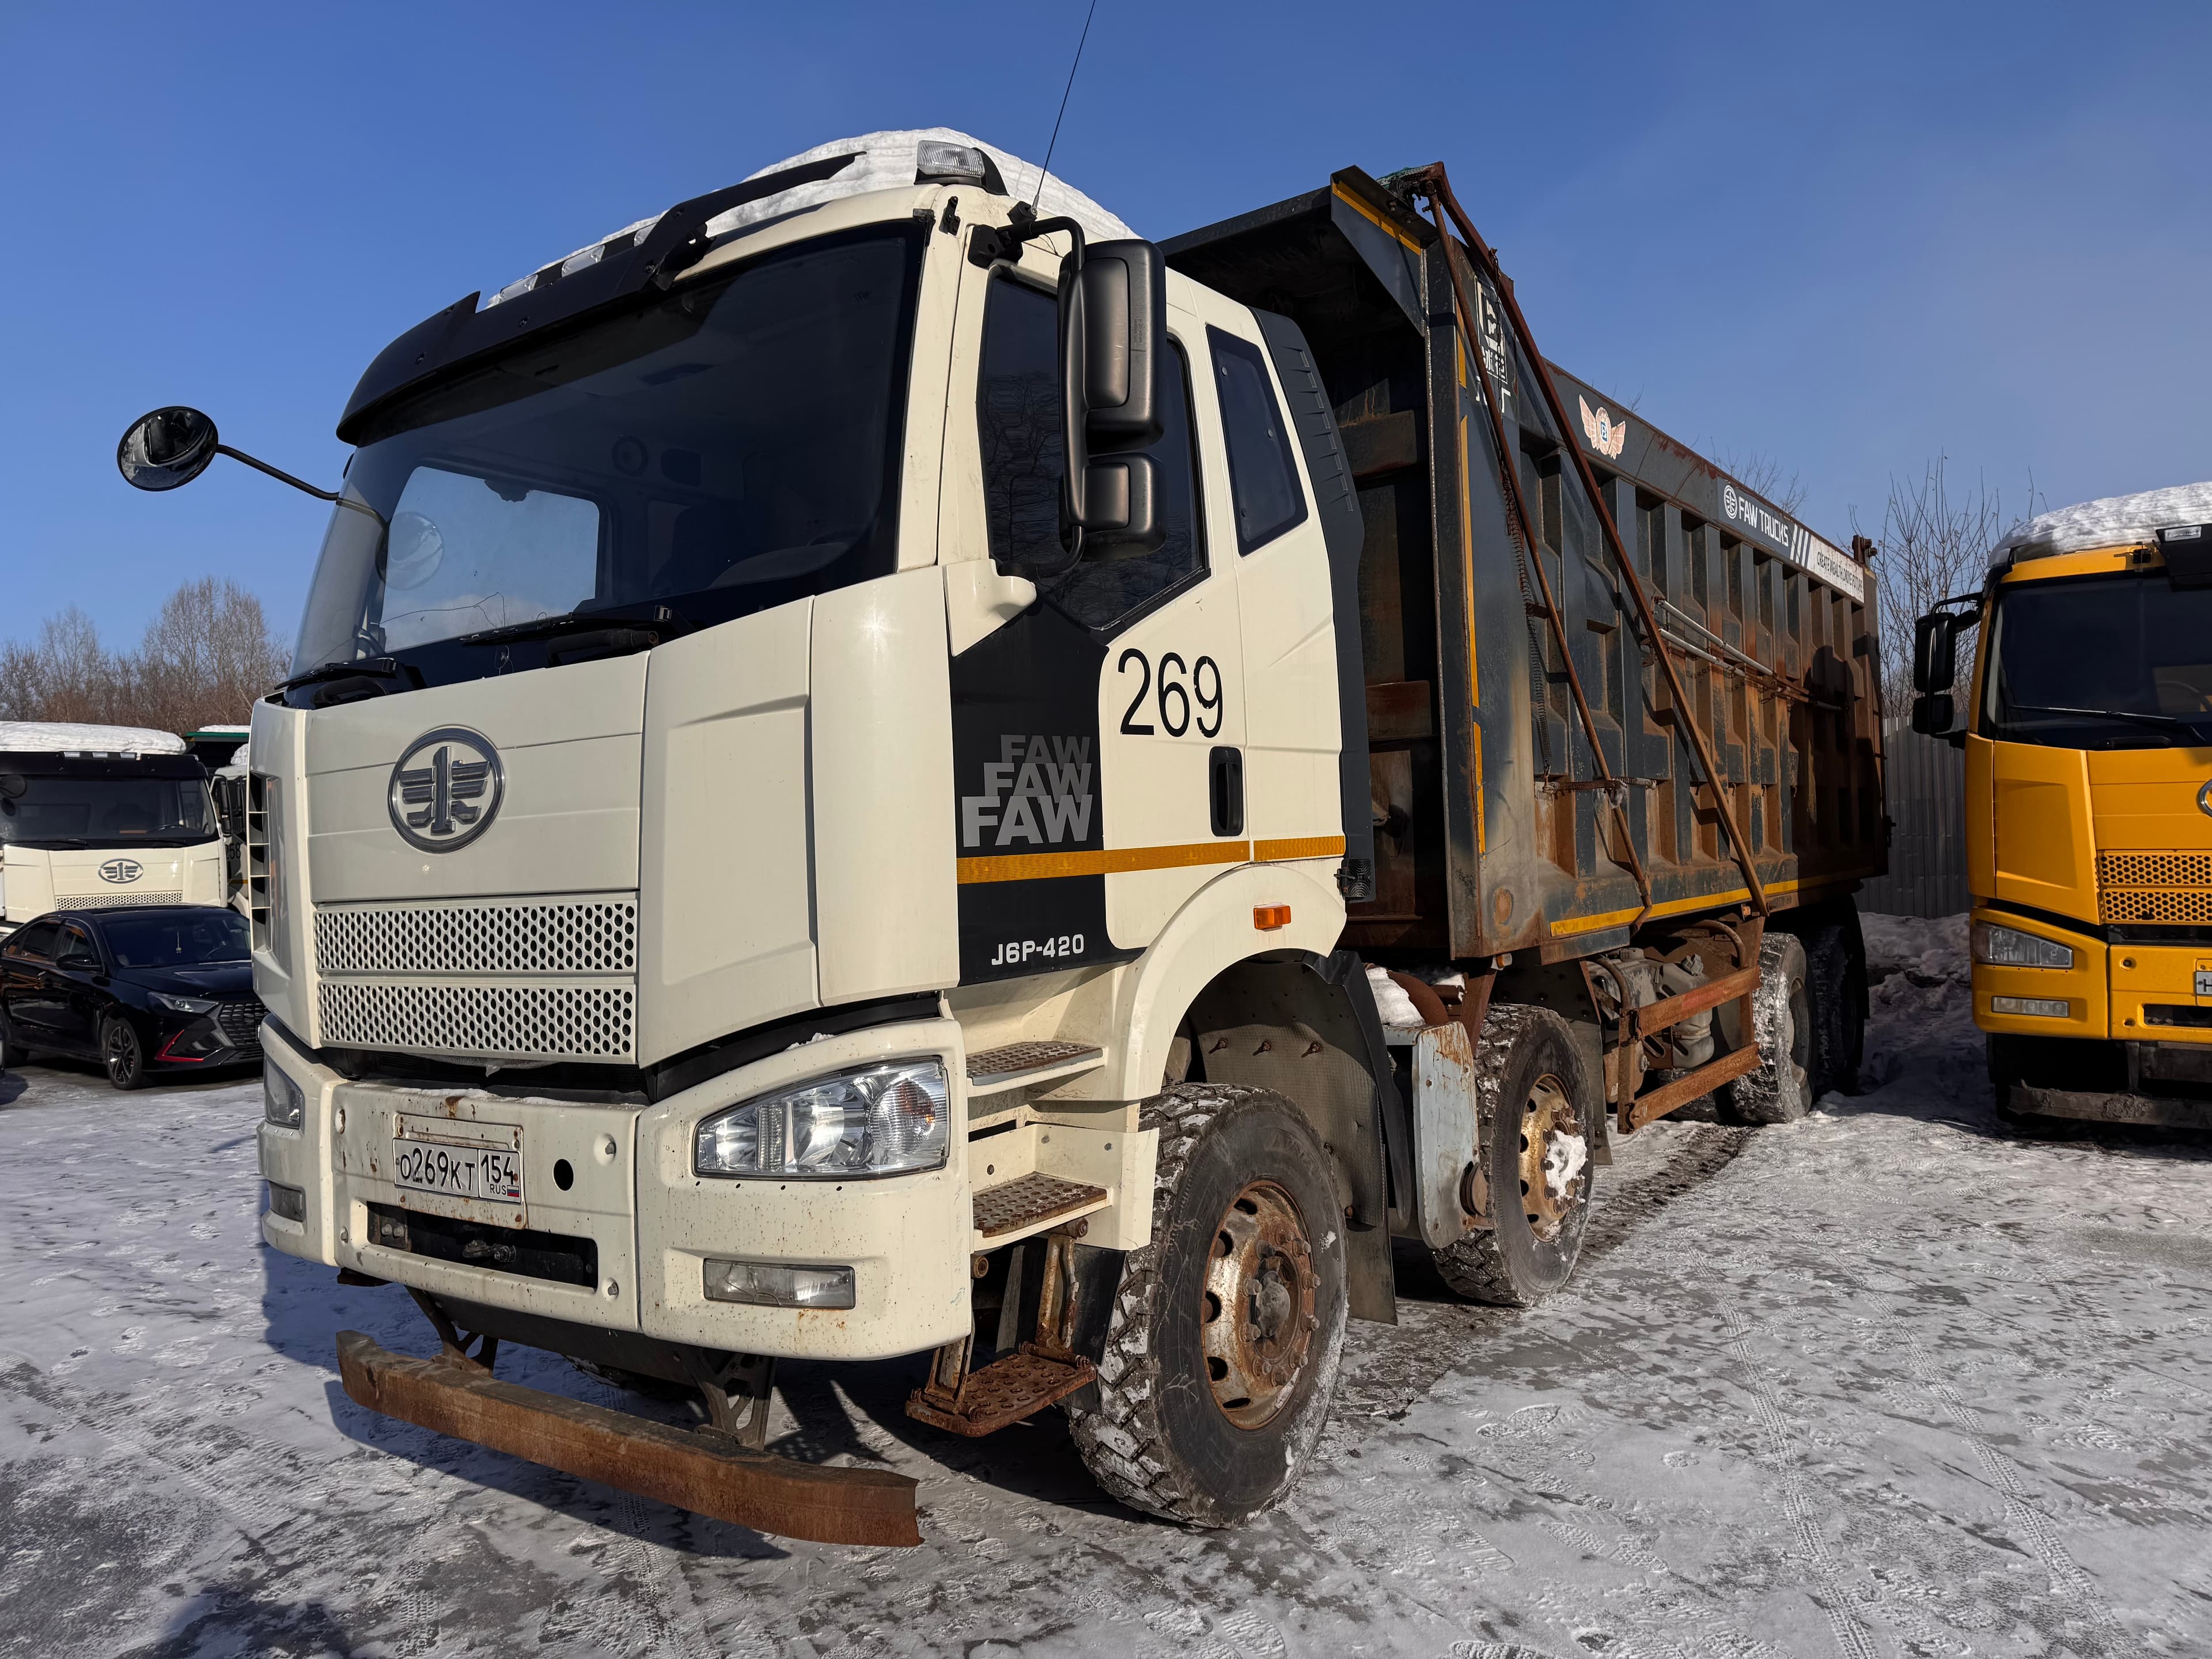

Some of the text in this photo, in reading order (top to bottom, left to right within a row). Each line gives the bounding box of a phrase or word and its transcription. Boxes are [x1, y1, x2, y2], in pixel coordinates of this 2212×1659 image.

[1738, 496, 1789, 547] FAW TRUCKS
[1118, 648, 1223, 738] 269
[1001, 734, 1090, 770] FAW
[984, 762, 1092, 804] FAW
[962, 794, 1093, 847] FAW
[991, 934, 1084, 965] J6P-420
[481, 1154, 514, 1185] 154
[490, 1184, 506, 1195] RUS
